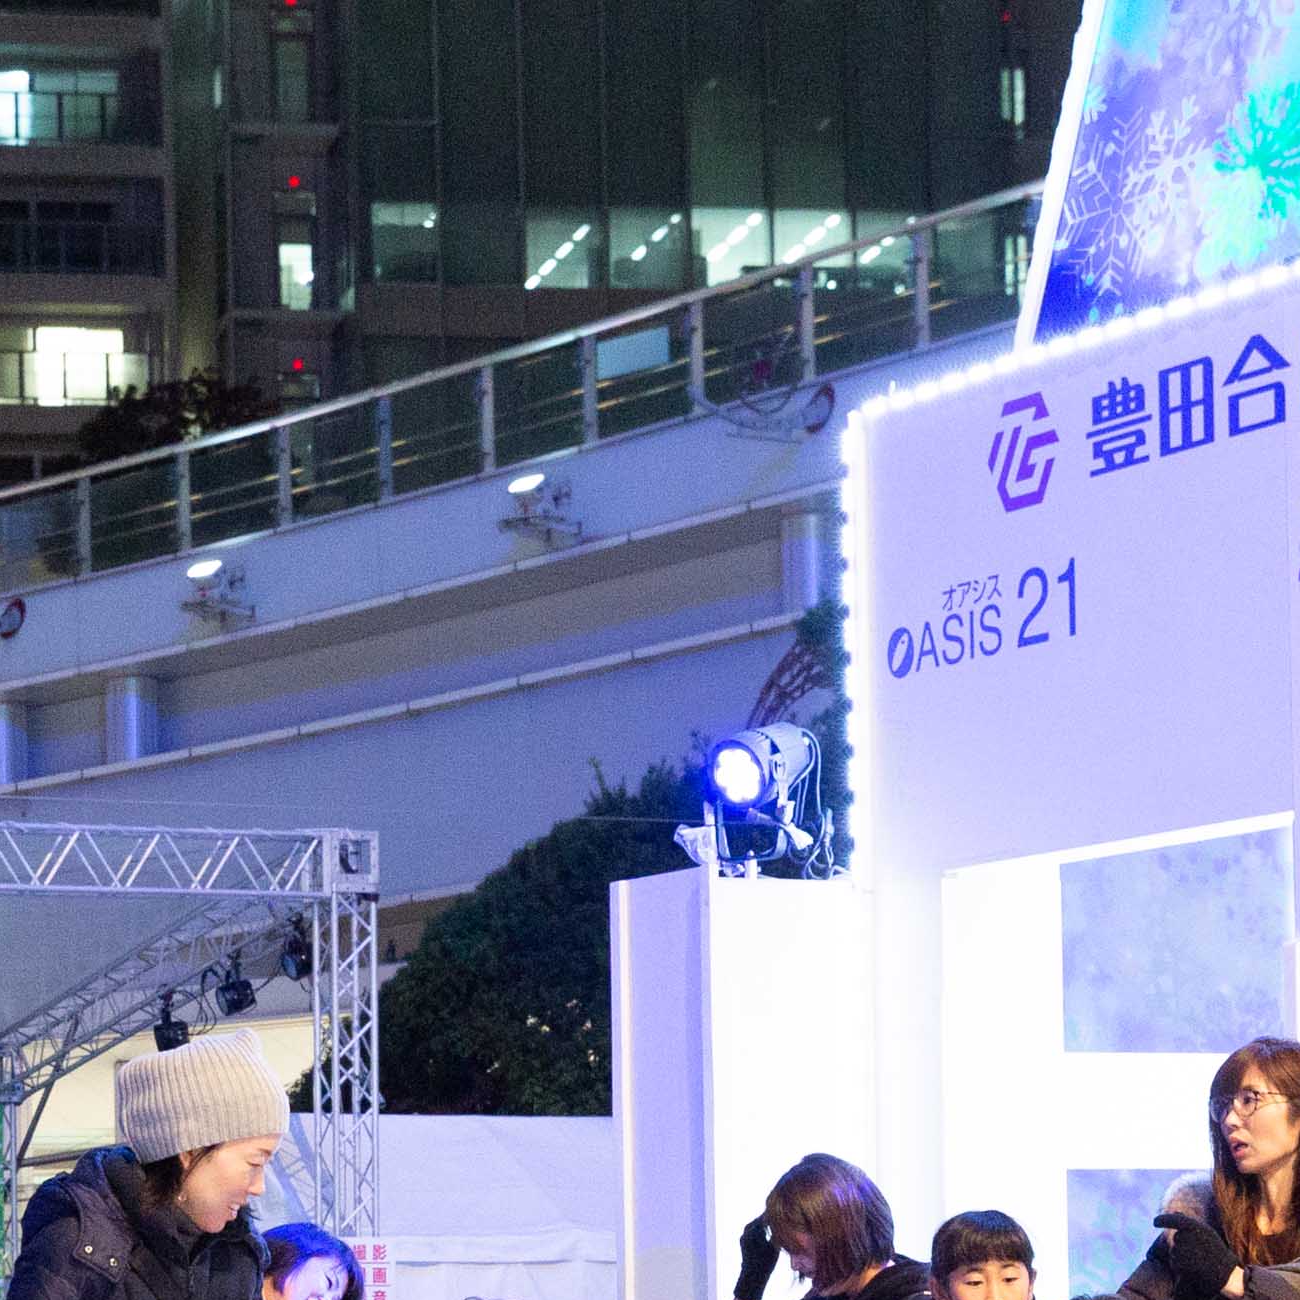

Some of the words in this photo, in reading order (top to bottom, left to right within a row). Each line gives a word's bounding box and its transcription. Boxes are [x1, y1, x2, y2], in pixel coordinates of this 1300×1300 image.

[887, 604, 1002, 679] OASIS
[1017, 557, 1076, 648] 21
[942, 574, 1002, 611] オアシス
